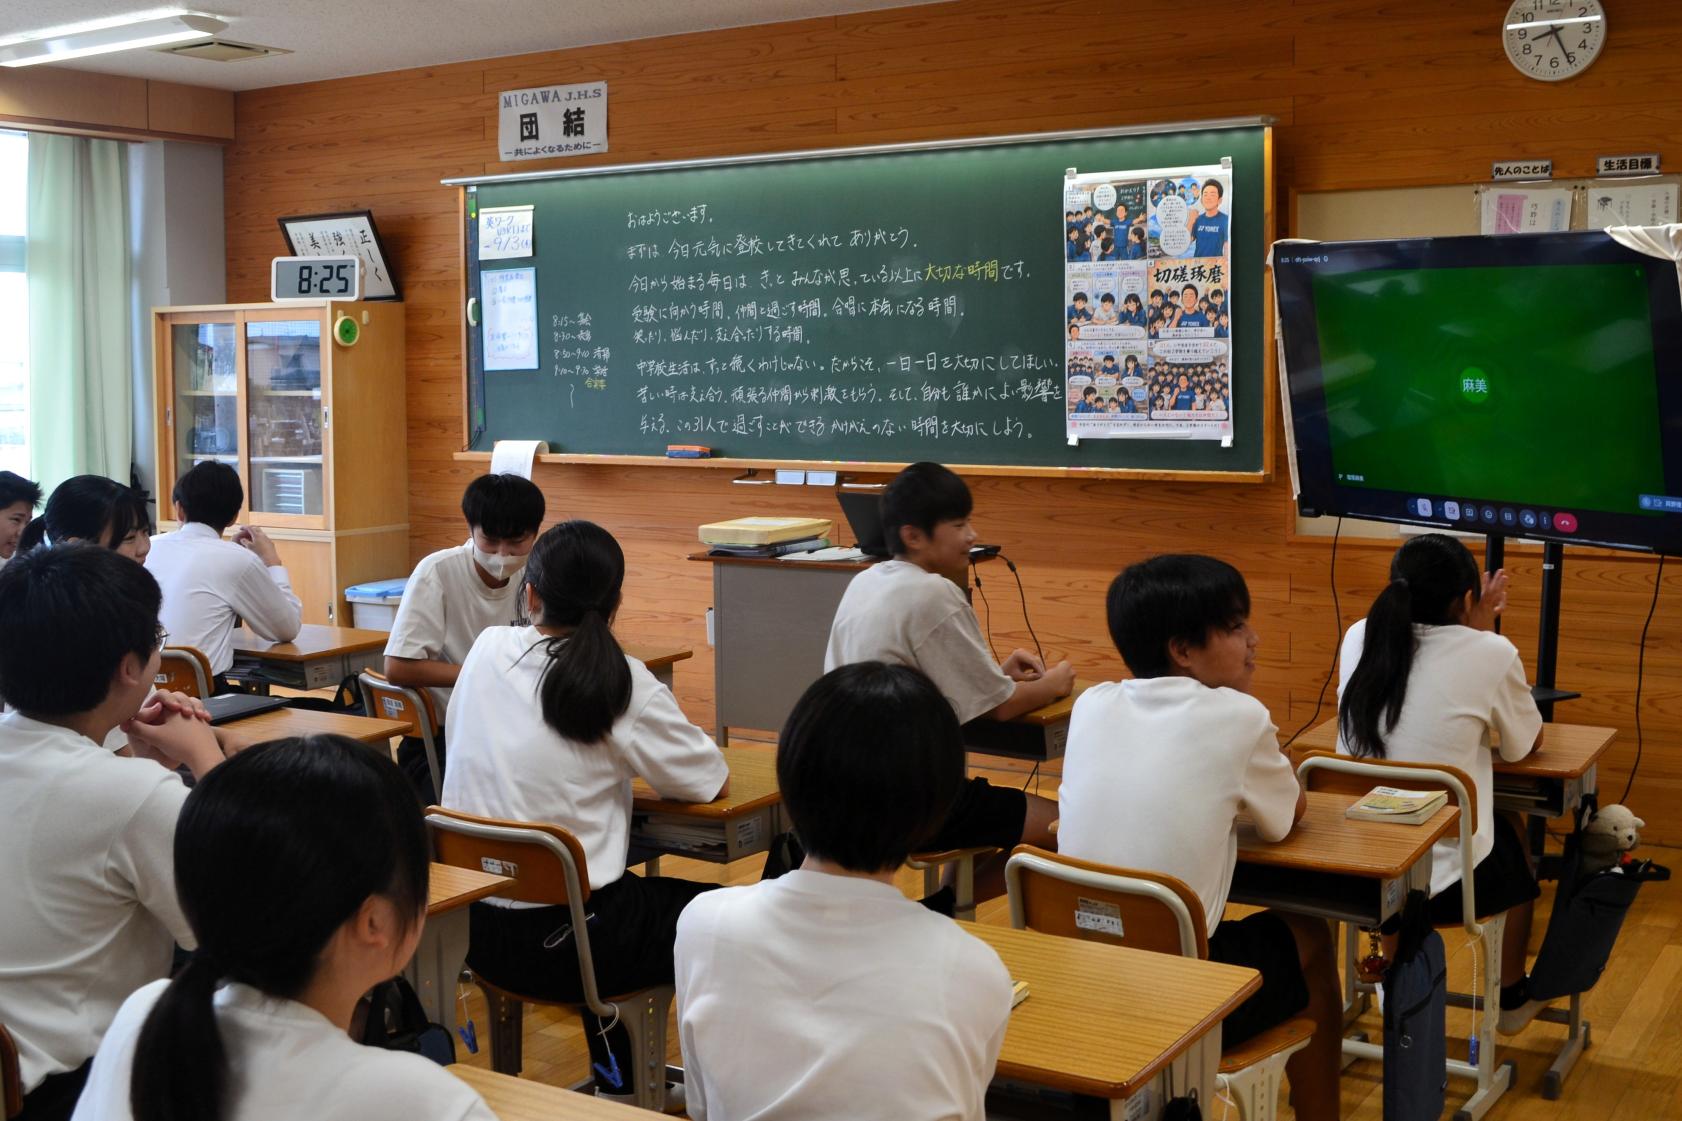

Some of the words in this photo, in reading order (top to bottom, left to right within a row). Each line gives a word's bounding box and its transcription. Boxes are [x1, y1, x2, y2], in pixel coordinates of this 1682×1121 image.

[1522, 12, 1534, 22] 10
[1578, 7, 1588, 17] 2
[1518, 28, 1527, 40] 9
[1583, 22, 1592, 34] 3
[1522, 43, 1532, 54] 8
[1578, 39, 1587, 50] 4
[1534, 54, 1543, 66] 7
[1550, 57, 1560, 68] 6
[1567, 52, 1576, 64] 5
[503, 90, 561, 109] MIGAWA
[564, 88, 602, 102] J.H.S
[1494, 164, 1550, 176] 先人のことば
[1604, 158, 1653, 172] 生活目標
[298, 264, 349, 294] 8:25
[1154, 264, 1224, 284] 切磋琢磨
[1462, 378, 1488, 393] 麻美
